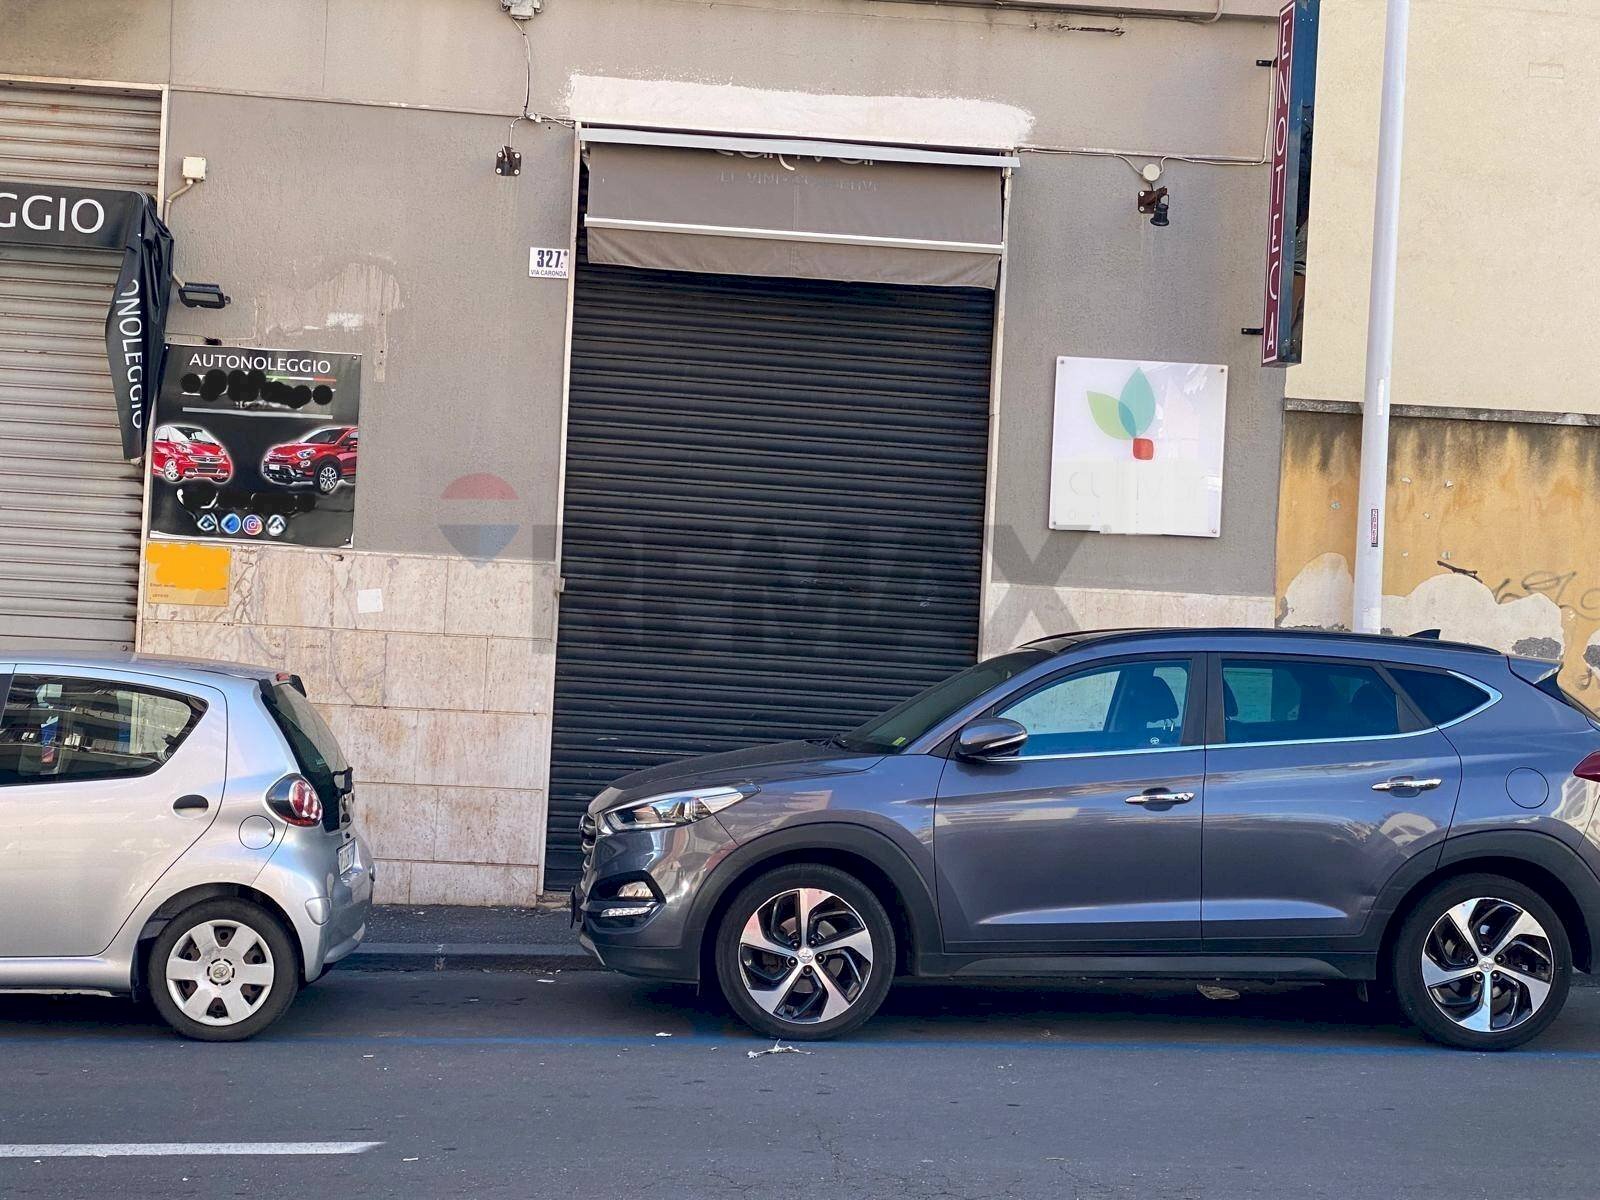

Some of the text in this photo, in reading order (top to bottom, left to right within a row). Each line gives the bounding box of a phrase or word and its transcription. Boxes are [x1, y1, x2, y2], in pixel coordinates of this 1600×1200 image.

[1266, 18, 1291, 352] ENOTECA
[540, 269, 567, 278] CARONDA
[189, 353, 332, 375] AUTONOLEGGIO
